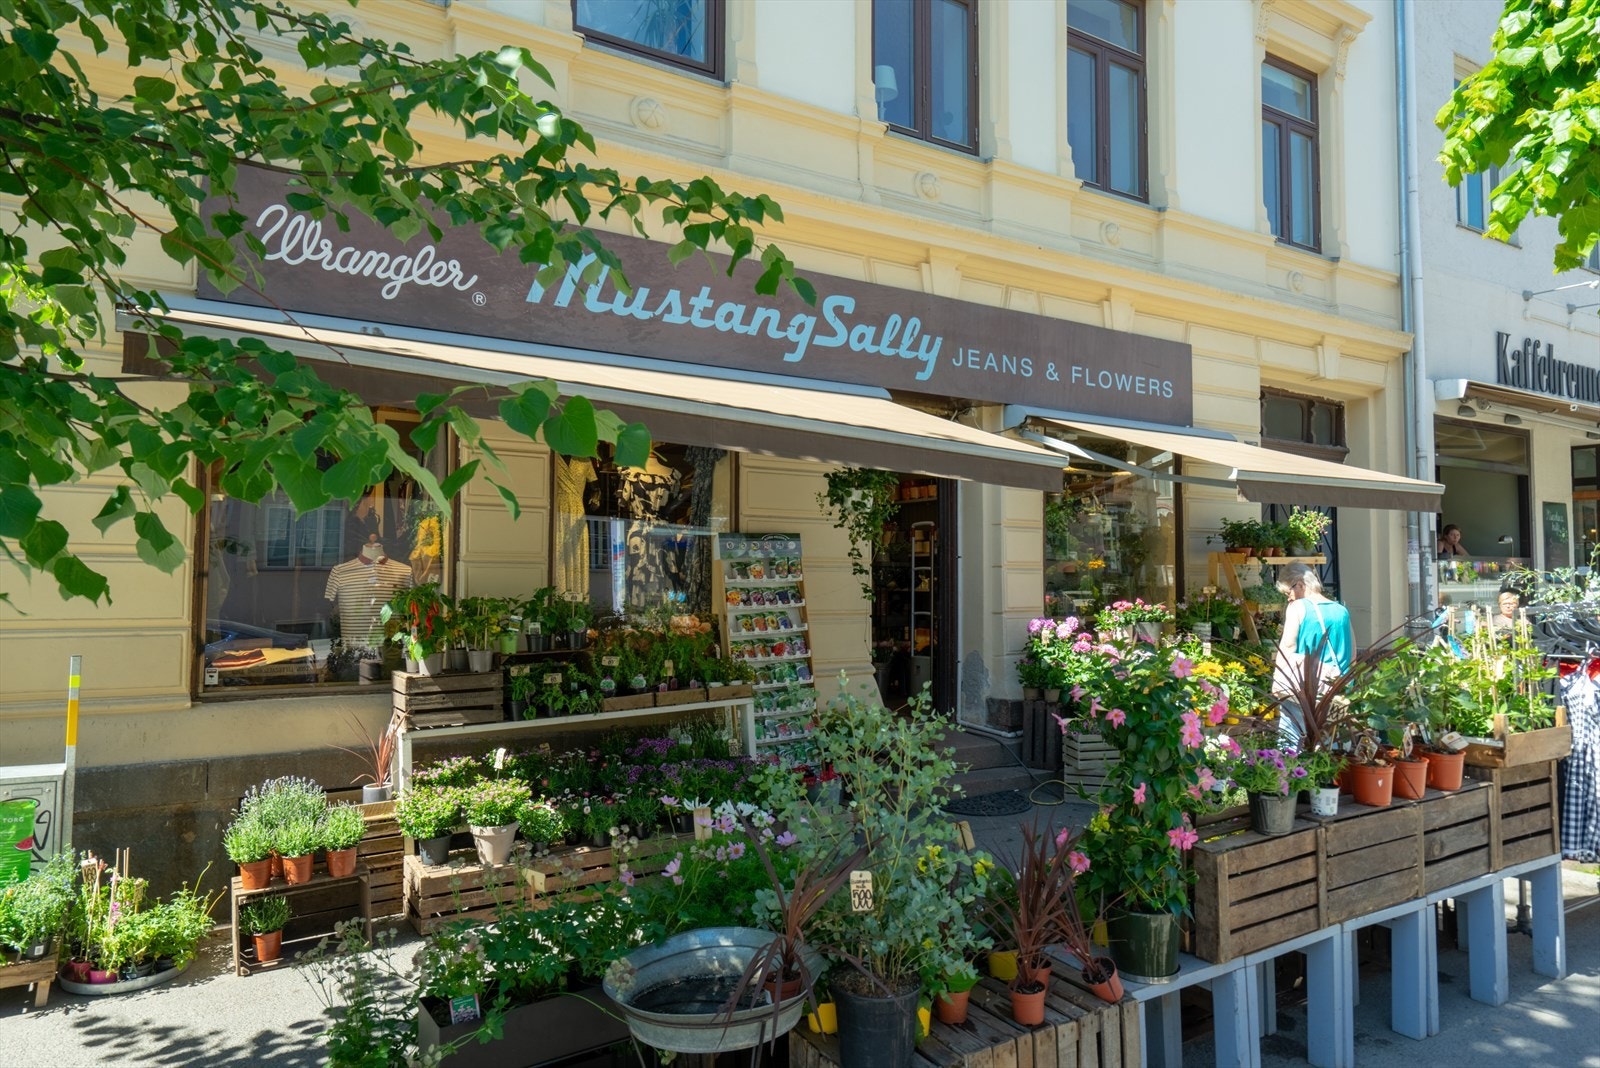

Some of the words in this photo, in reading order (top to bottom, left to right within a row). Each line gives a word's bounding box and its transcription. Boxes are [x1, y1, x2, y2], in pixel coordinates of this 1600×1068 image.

[255, 203, 479, 300] Wrangler
[952, 347, 1034, 378] JEANS
[1045, 363, 1060, 382] &
[1071, 366, 1174, 399] FLOWERS
